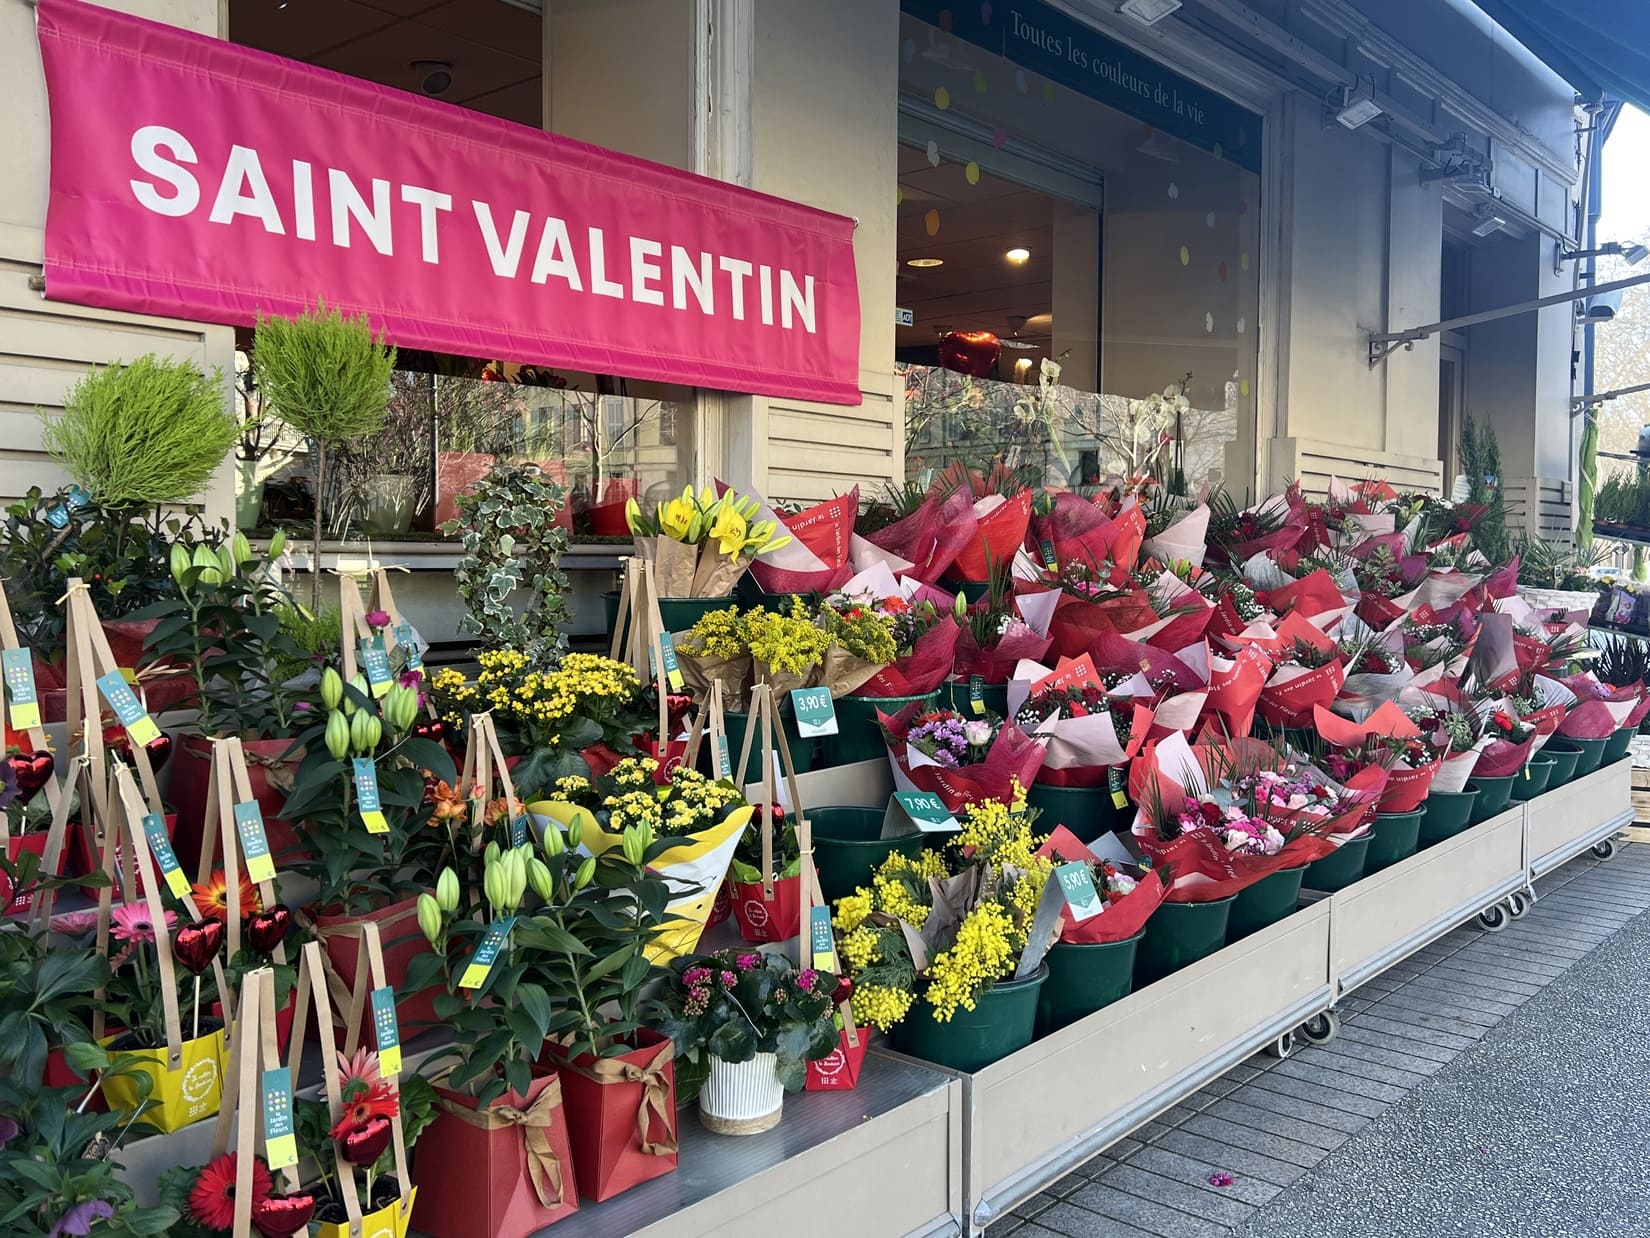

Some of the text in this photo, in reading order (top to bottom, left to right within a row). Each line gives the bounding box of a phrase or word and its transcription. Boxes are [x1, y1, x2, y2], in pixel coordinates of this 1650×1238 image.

[1010, 10, 1204, 124] Toutes les couleurs de la vie
[129, 125, 817, 334] SAINT VALENTIN
[791, 513, 825, 531] le Jardin
[1294, 676, 1315, 688] Jardin
[798, 694, 828, 712] 3,90 €
[934, 772, 956, 794] Jardin
[1395, 774, 1417, 782] Jardin
[904, 798, 941, 811] 7,90 €
[1064, 869, 1088, 891] 5,90 €
